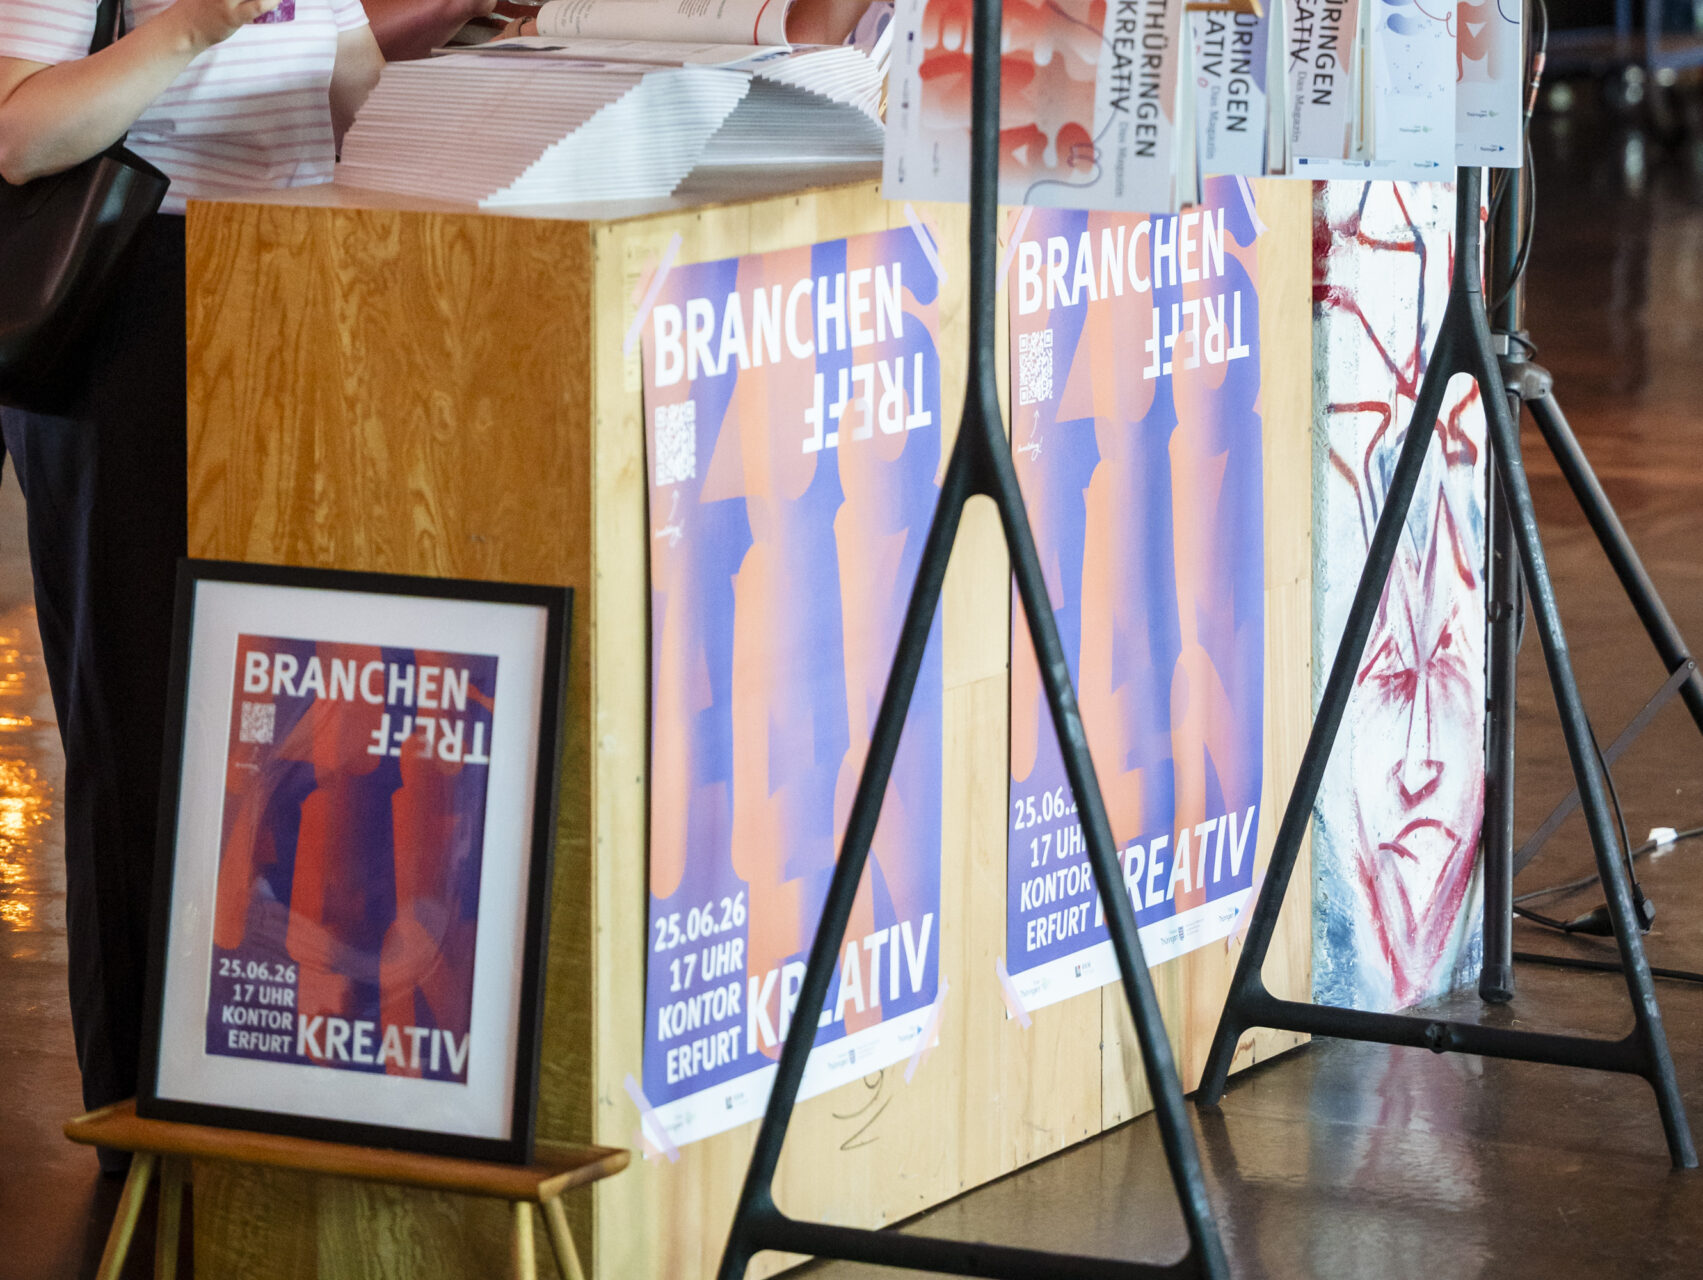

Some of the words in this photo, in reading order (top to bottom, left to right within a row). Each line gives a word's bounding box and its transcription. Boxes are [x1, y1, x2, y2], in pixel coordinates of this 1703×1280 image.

[1110, 0, 1139, 113] KREATIV
[1018, 207, 1225, 316] BRANCHEN
[653, 262, 903, 388] BRANCHEN
[243, 651, 469, 712] BRANCHEN
[1014, 785, 1079, 831] 25.06.
[1030, 833, 1051, 868] 17
[1020, 861, 1092, 913] KONTOR
[654, 890, 746, 953] 25.06.26
[1026, 901, 1091, 952] ERFURT
[219, 958, 296, 984] 25.06.26
[670, 952, 697, 992] 17
[701, 937, 744, 982] UHR
[222, 1005, 293, 1030] KONTOR
[233, 984, 251, 1002] 17
[258, 986, 295, 1007] UHR
[658, 981, 741, 1042] KONTOR
[228, 1029, 292, 1053] ERFURT
[296, 1014, 470, 1075] KREATIV
[667, 1025, 742, 1085] ERFURT
